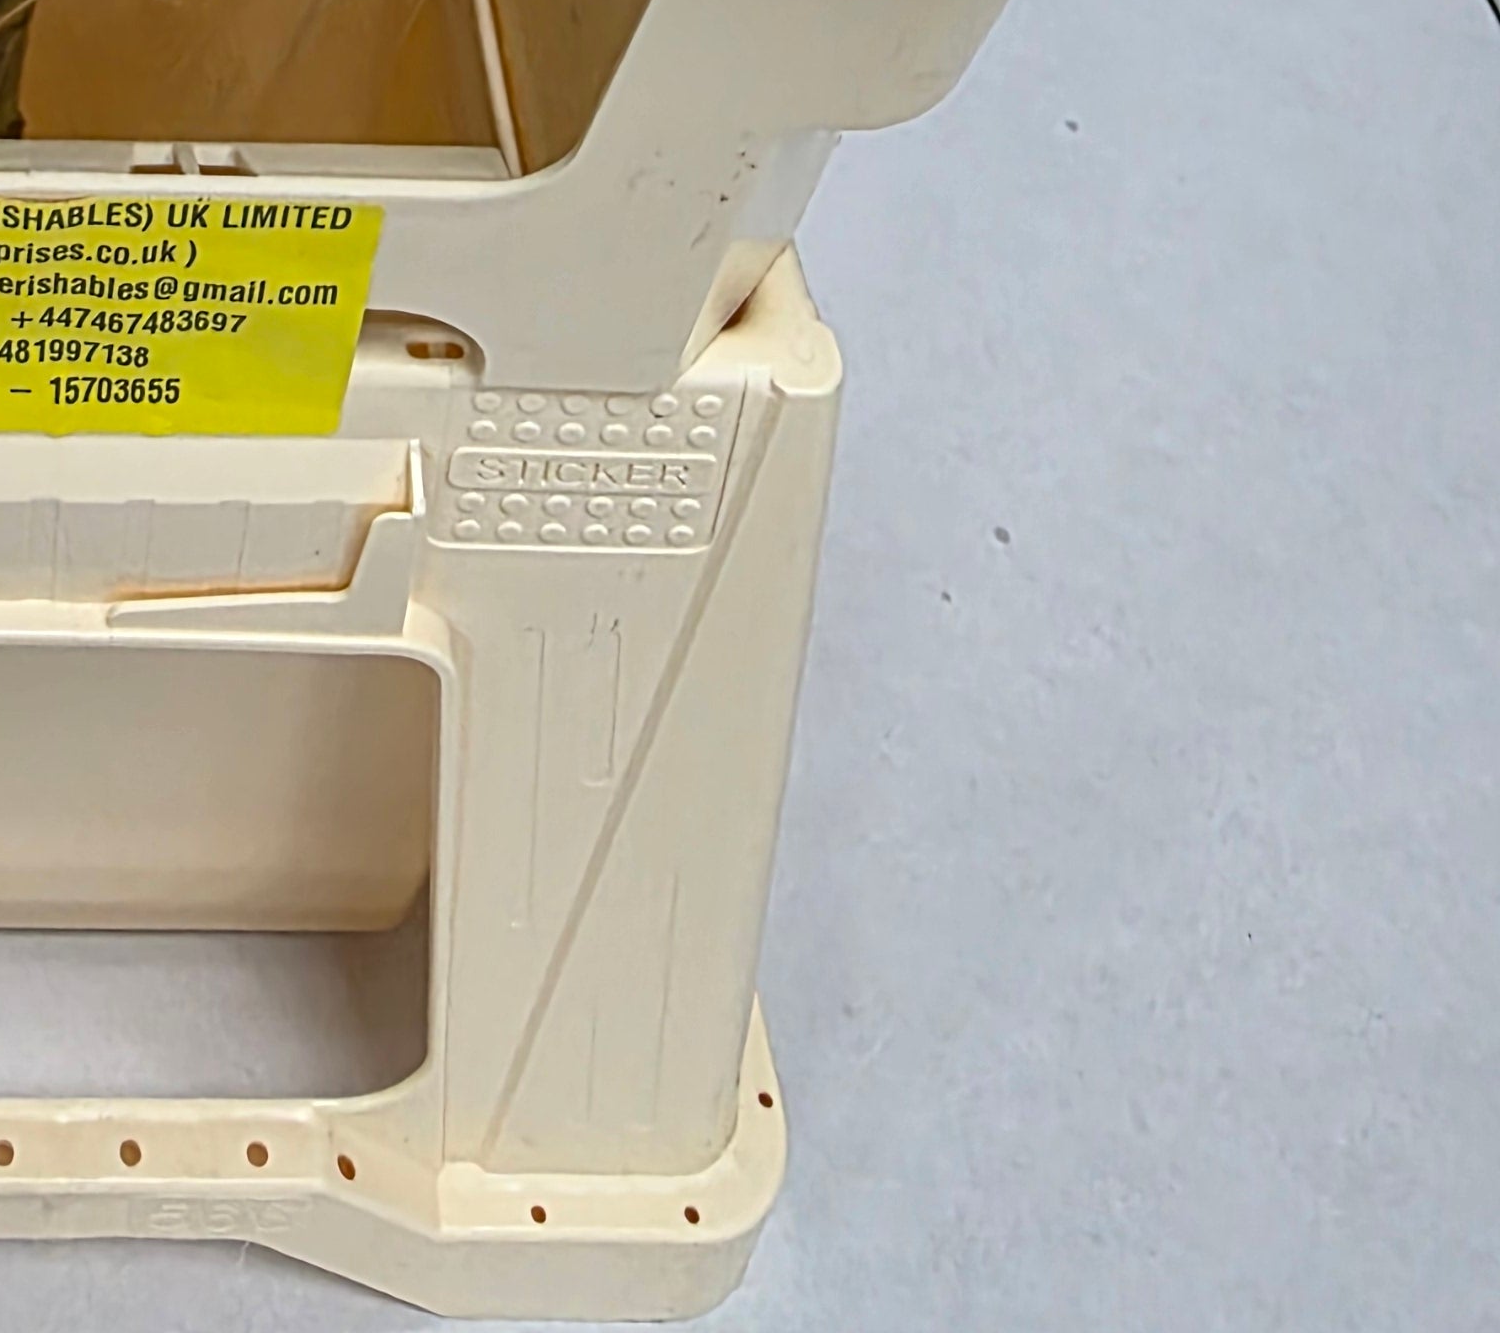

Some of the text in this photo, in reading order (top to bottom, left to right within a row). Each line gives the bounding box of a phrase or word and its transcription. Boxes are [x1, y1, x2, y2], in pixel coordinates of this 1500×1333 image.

[167, 203, 210, 229] UK
[223, 205, 353, 230] LIMITED
[11, 306, 247, 334] +447467483697
[49, 376, 181, 405] 15703655
[476, 457, 690, 489] STICKER
